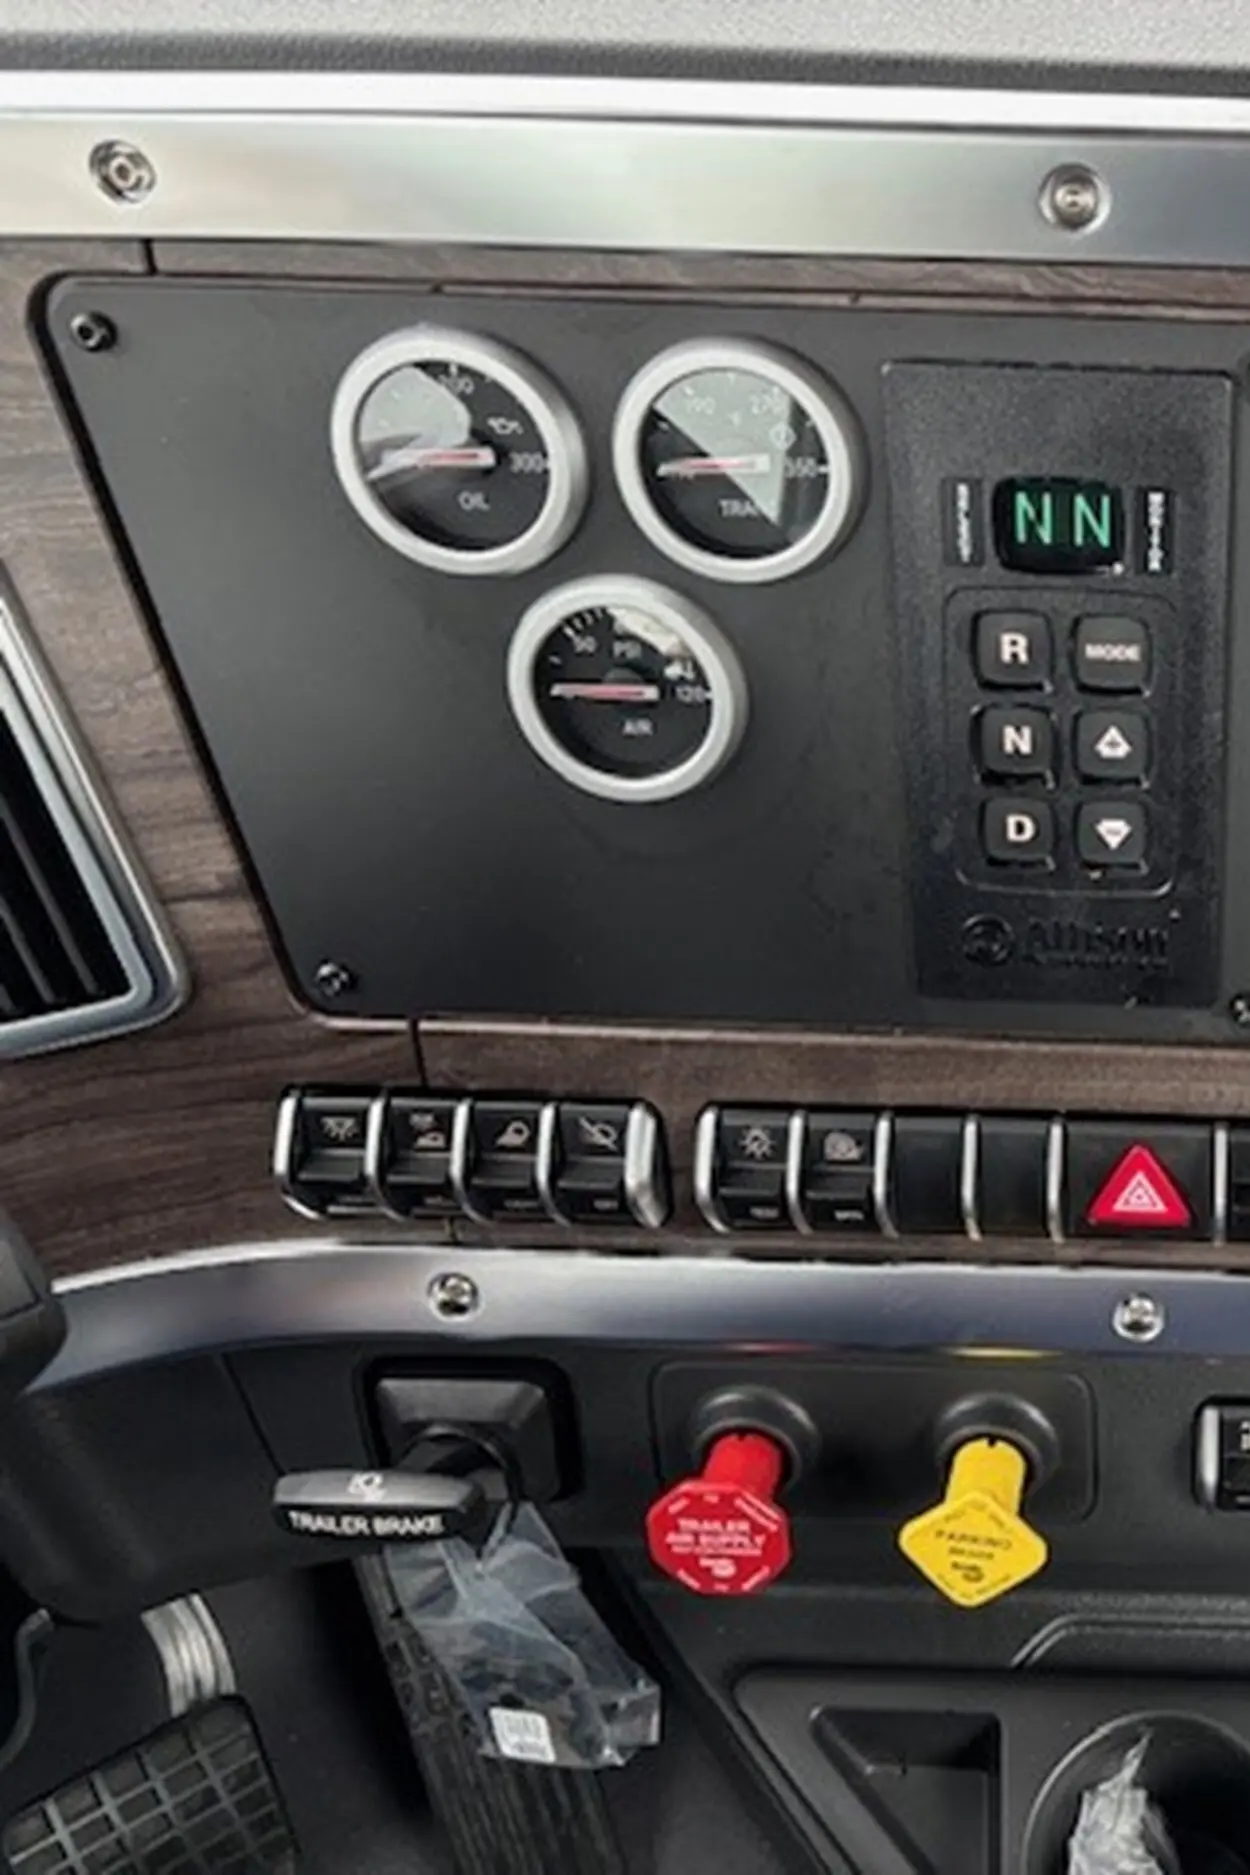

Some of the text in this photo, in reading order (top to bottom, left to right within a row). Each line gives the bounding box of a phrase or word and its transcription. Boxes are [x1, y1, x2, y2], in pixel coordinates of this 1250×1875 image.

[457, 492, 490, 511] OIL
[1000, 631, 1029, 664] R
[1084, 642, 1141, 662] MODE
[622, 718, 654, 736] AIR
[1003, 724, 1033, 755] N
[1005, 813, 1036, 843] D
[289, 1509, 445, 1537] TRAILER BRAKE
